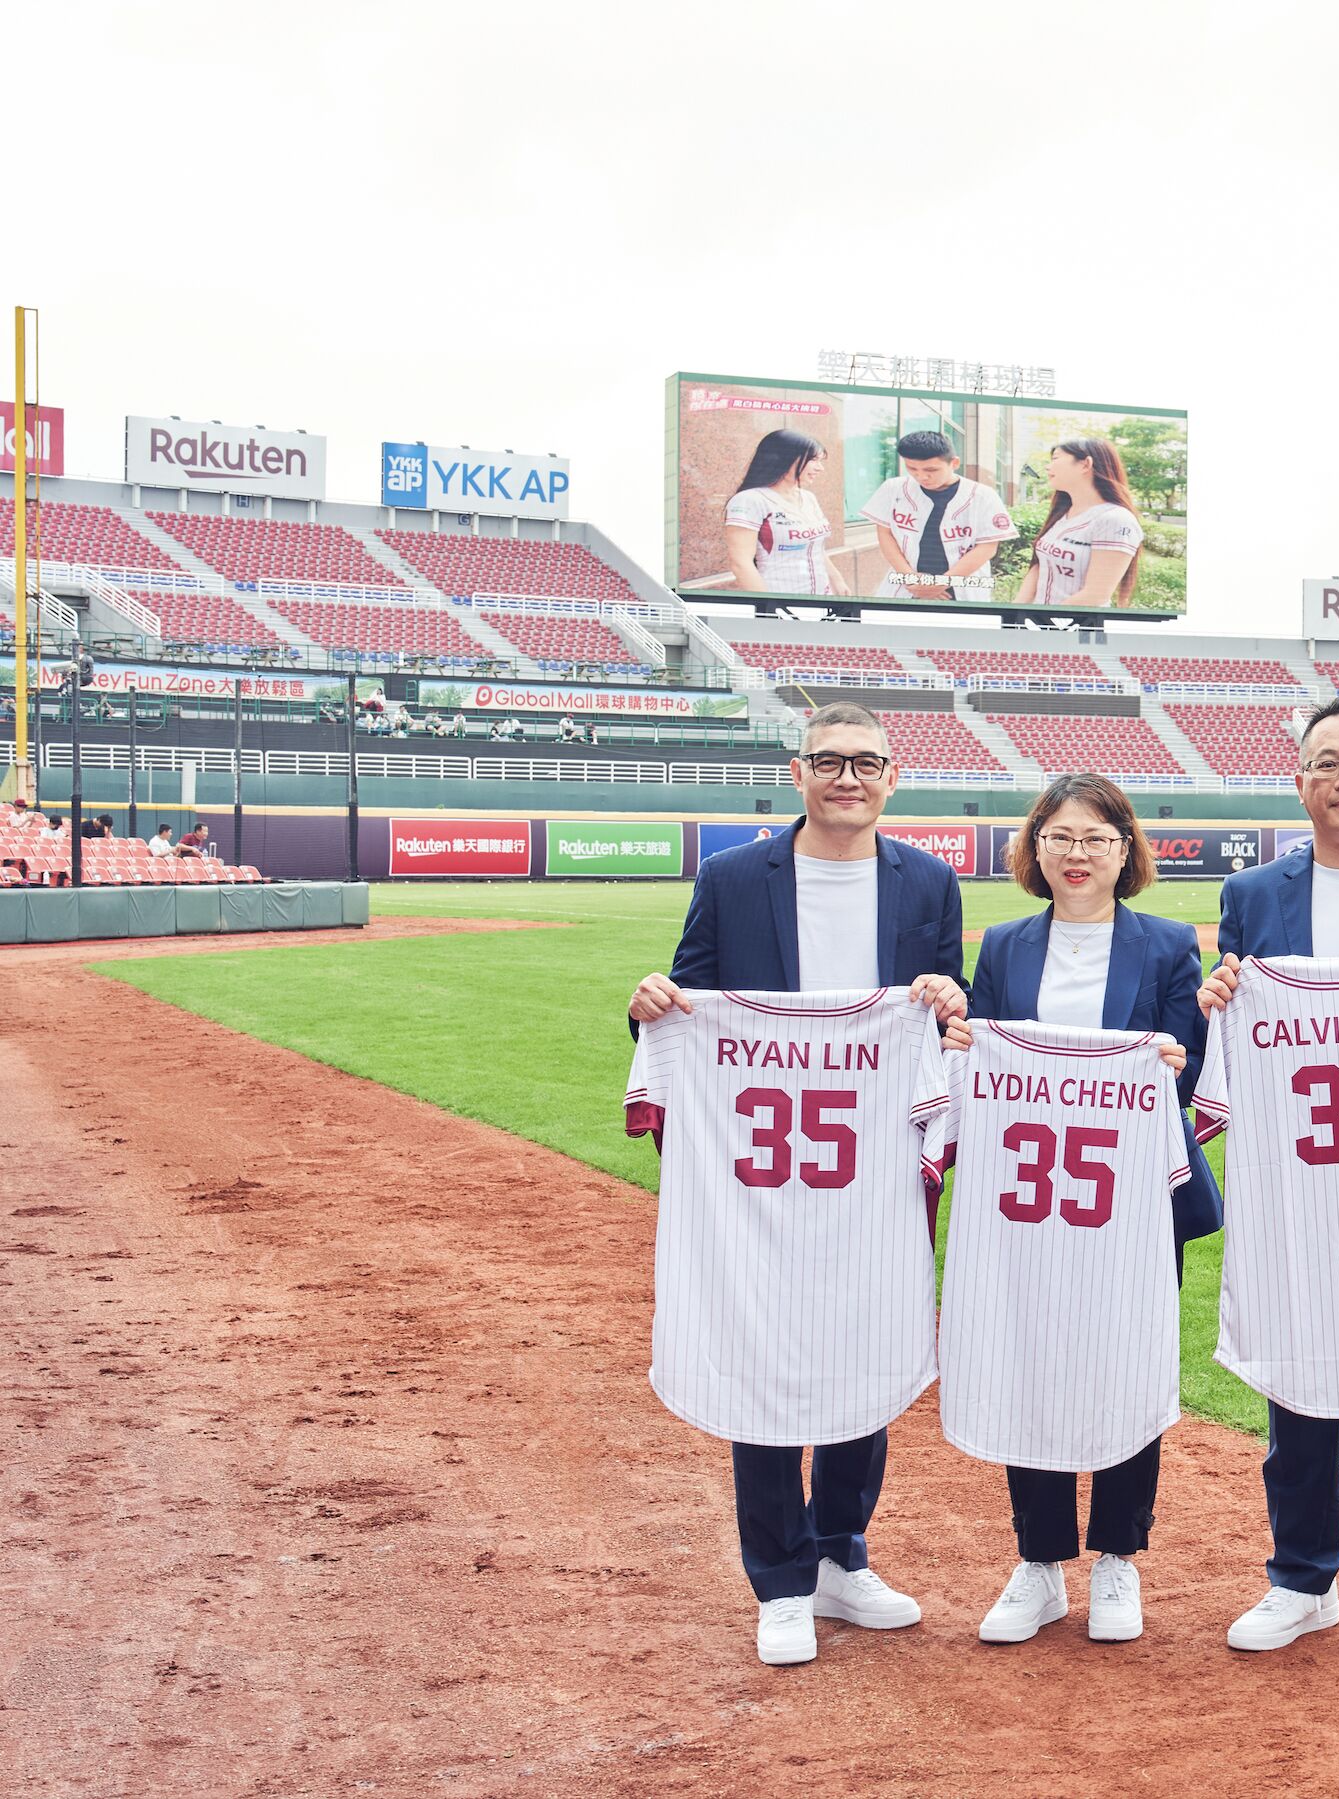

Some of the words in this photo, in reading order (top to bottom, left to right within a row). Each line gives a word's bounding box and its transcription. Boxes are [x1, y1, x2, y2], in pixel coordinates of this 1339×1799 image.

[0, 416, 50, 460] all
[150, 428, 307, 477] Rakuten
[388, 455, 423, 472] YKK
[432, 460, 513, 500] YKK
[519, 469, 569, 503] AP
[124, 671, 163, 691] Fun
[165, 673, 216, 693] Zone
[495, 689, 554, 708] Global
[557, 692, 593, 710] Mall
[595, 694, 690, 712] 環球購物中心
[396, 837, 450, 854] Rakuten
[452, 839, 526, 855] 樂天國際銀行
[558, 838, 619, 856] Rakuten
[620, 841, 671, 856] 樂天旅遊
[933, 834, 966, 851] Mall
[1220, 842, 1256, 857] BLACK
[717, 1038, 811, 1070] RYAN
[823, 1042, 880, 1071] LIN
[973, 1071, 1051, 1104] LYDIA
[1059, 1078, 1156, 1112] CHENG
[734, 1087, 857, 1189] 35
[998, 1121, 1119, 1228] 35
